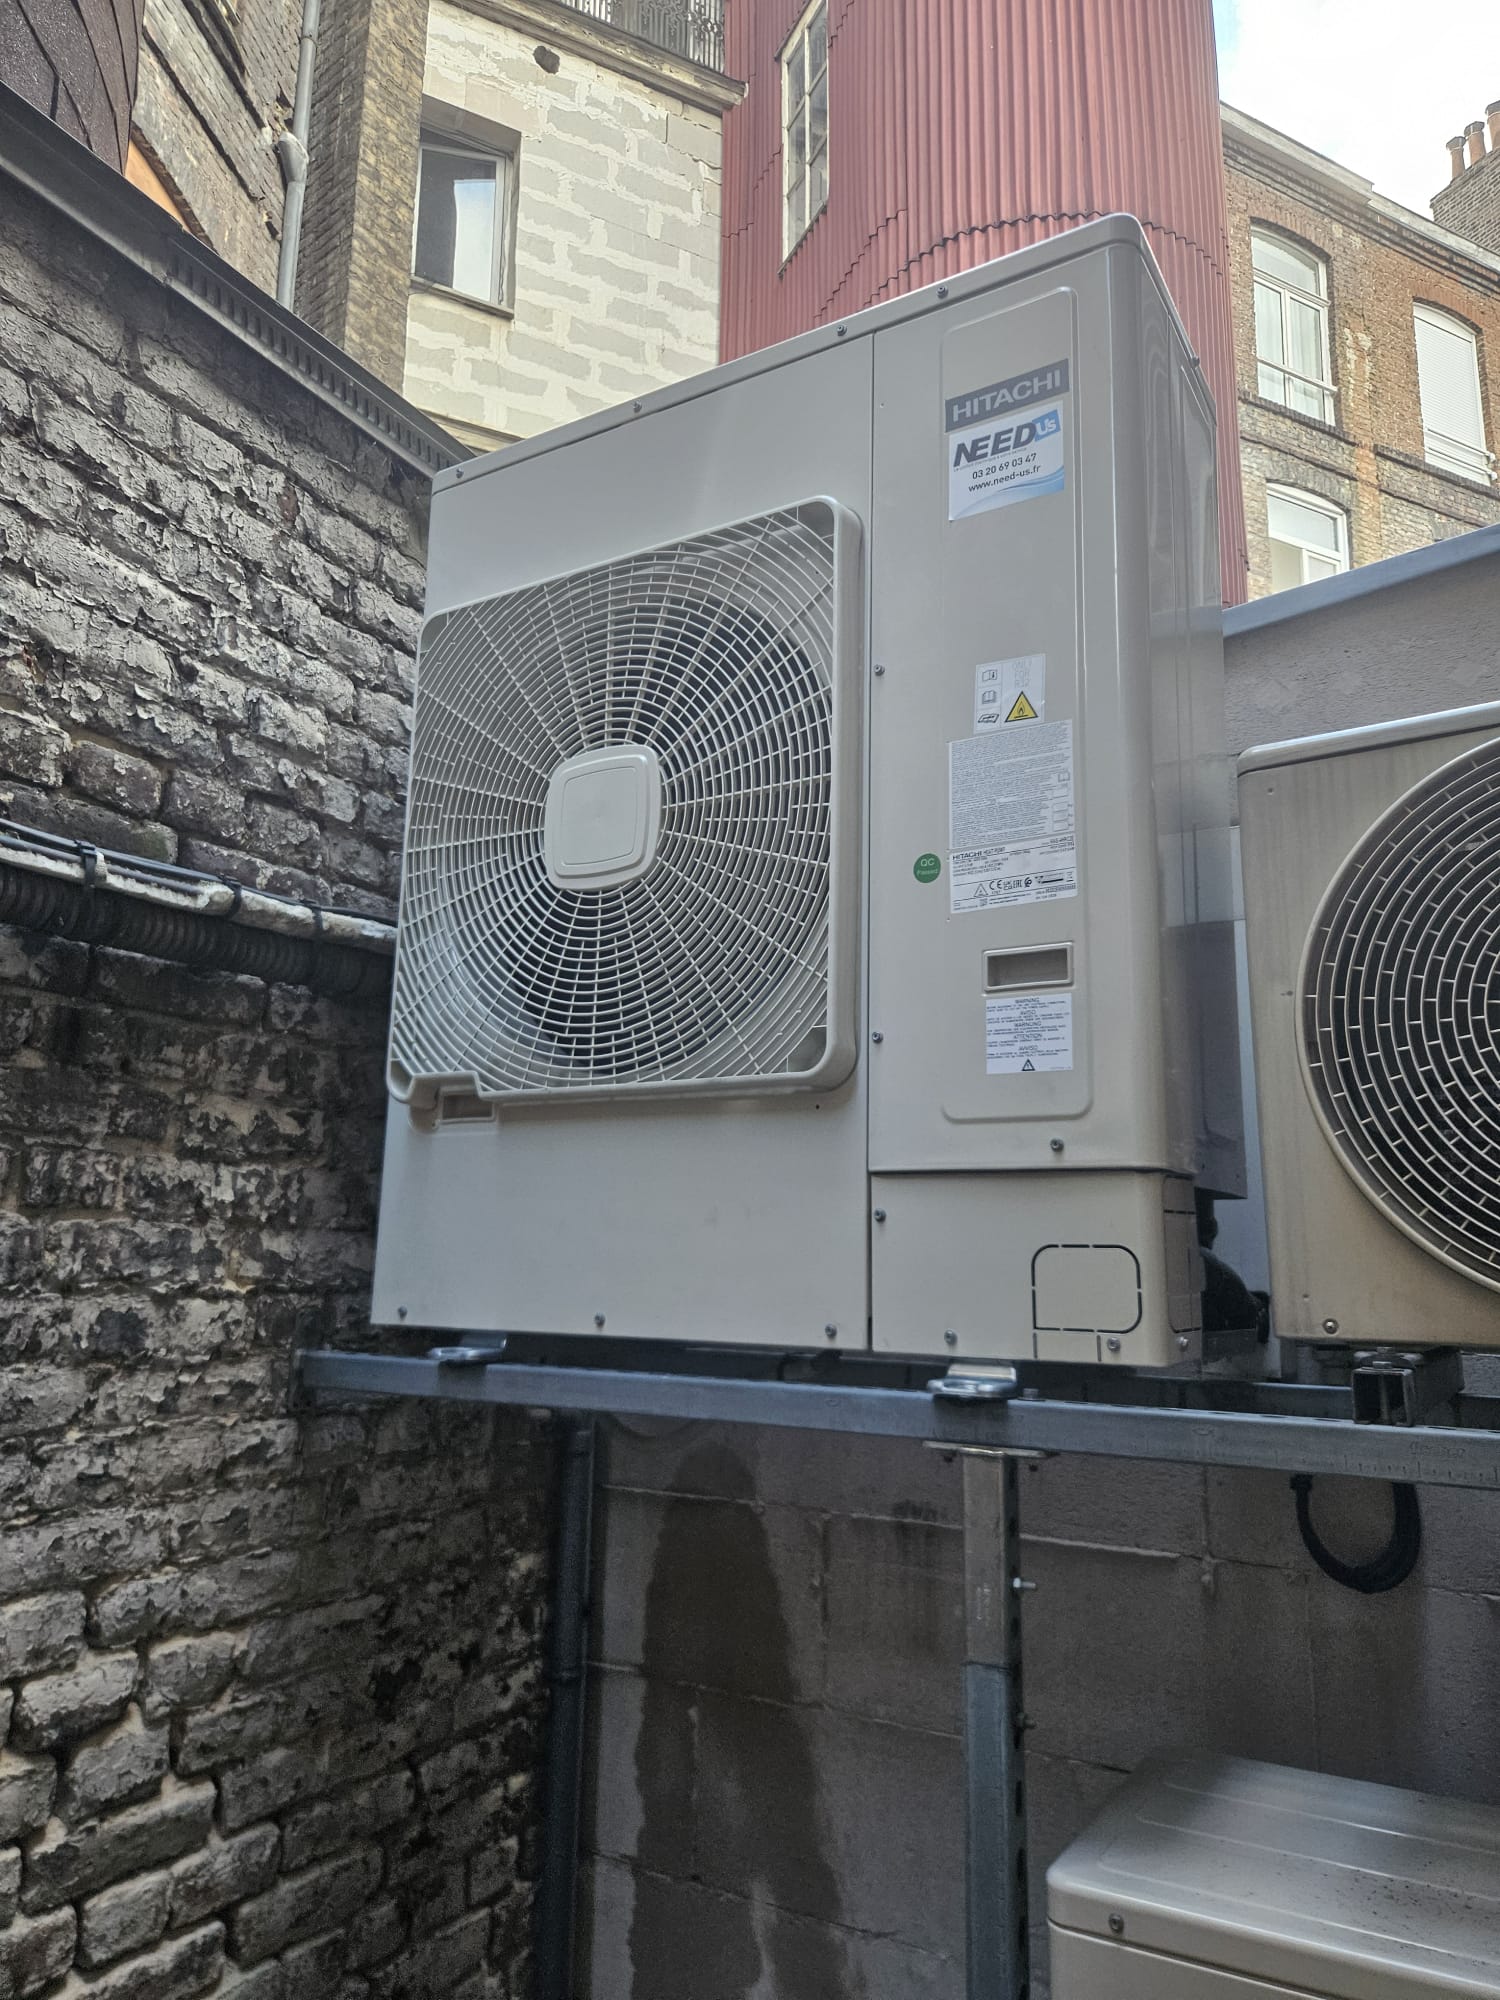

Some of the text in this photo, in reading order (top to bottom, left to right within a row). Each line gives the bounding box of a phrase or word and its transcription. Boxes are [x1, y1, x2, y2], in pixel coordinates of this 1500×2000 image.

[952, 369, 1060, 422] HITACHI
[968, 464, 1041, 492] www.need-us.fr
[972, 469, 984, 480] 03
[985, 465, 997, 476] 20
[998, 460, 1010, 472] 69
[1012, 457, 1023, 468] 03
[1025, 452, 1037, 465] 47
[920, 857, 935, 867] QC
[952, 851, 982, 860] HITACHI
